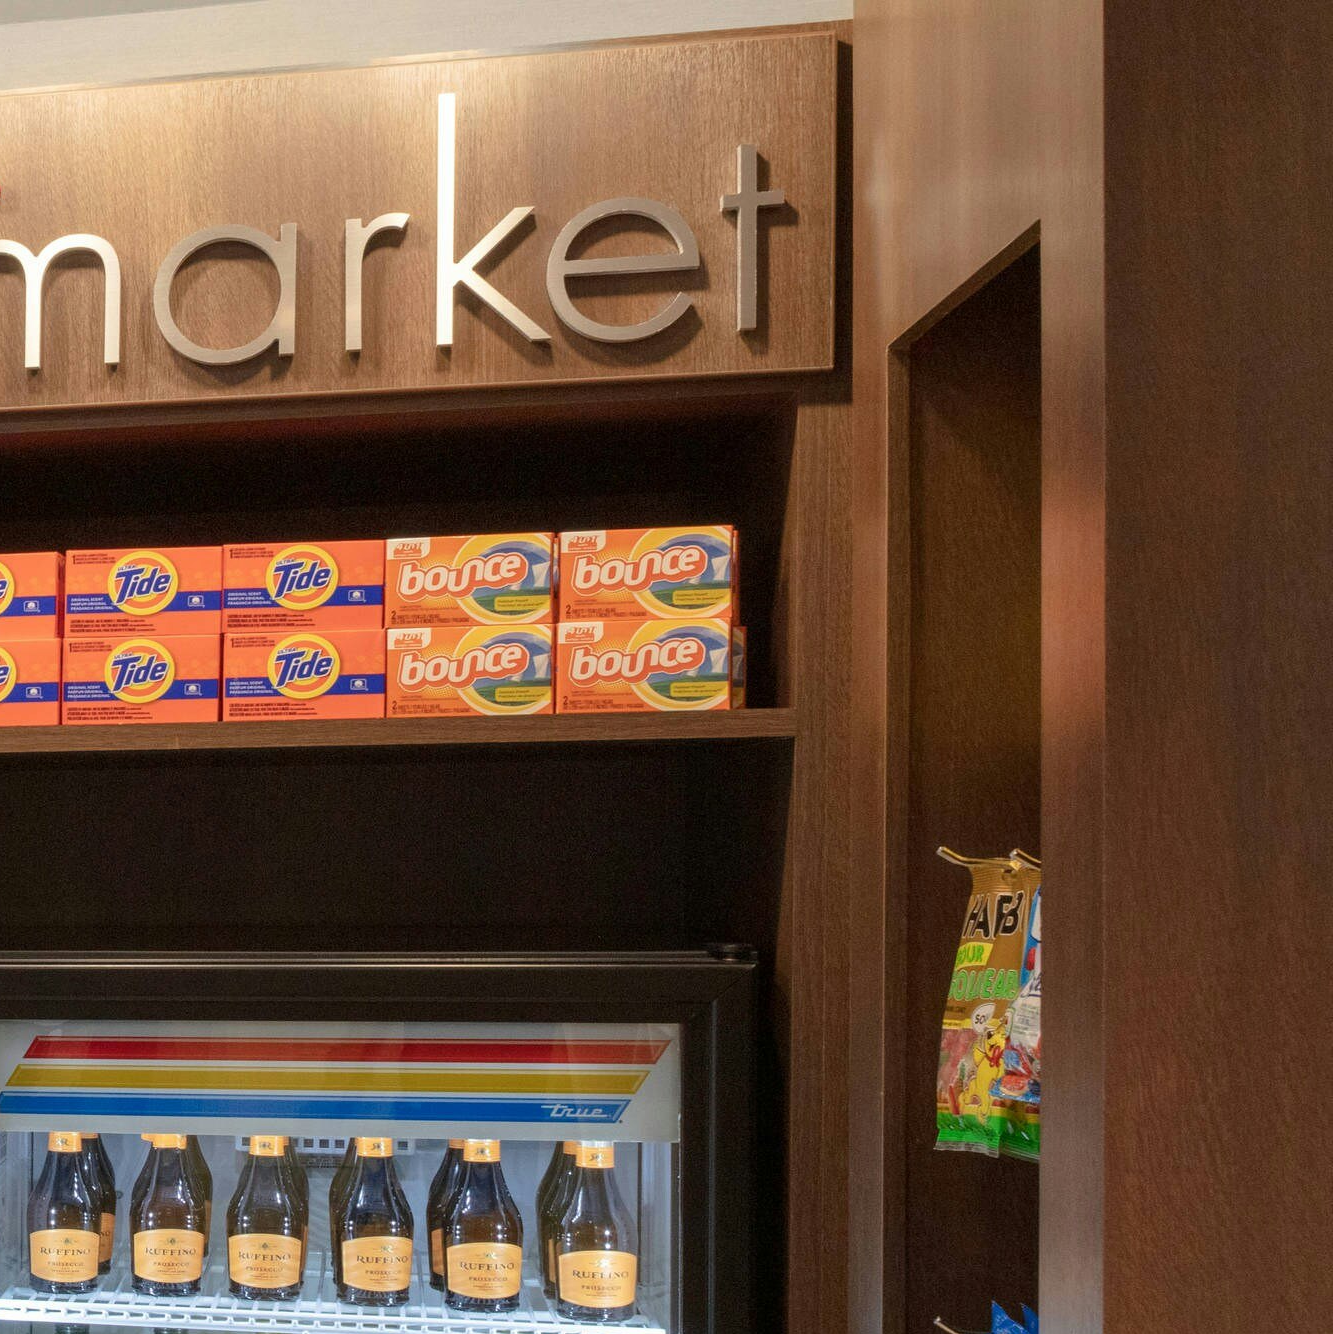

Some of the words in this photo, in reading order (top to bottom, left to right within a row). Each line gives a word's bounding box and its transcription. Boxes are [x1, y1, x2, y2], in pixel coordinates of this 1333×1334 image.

[114, 567, 173, 606] Tide
[273, 560, 333, 600] Tide
[399, 554, 523, 597] bounce
[574, 546, 704, 594] bounce
[110, 655, 169, 694] Tide
[274, 650, 334, 690] Tide
[399, 644, 523, 687] bounce
[571, 638, 703, 688] bounce
[541, 1102, 614, 1120] true
[40, 1246, 91, 1257] RUFFINO
[145, 1246, 197, 1256] RUFFINO
[238, 1251, 292, 1262] RUFFINO
[356, 1254, 410, 1266] RUFFINO
[459, 1261, 515, 1272] RUFFINO
[572, 1269, 630, 1280] RUFFINO
